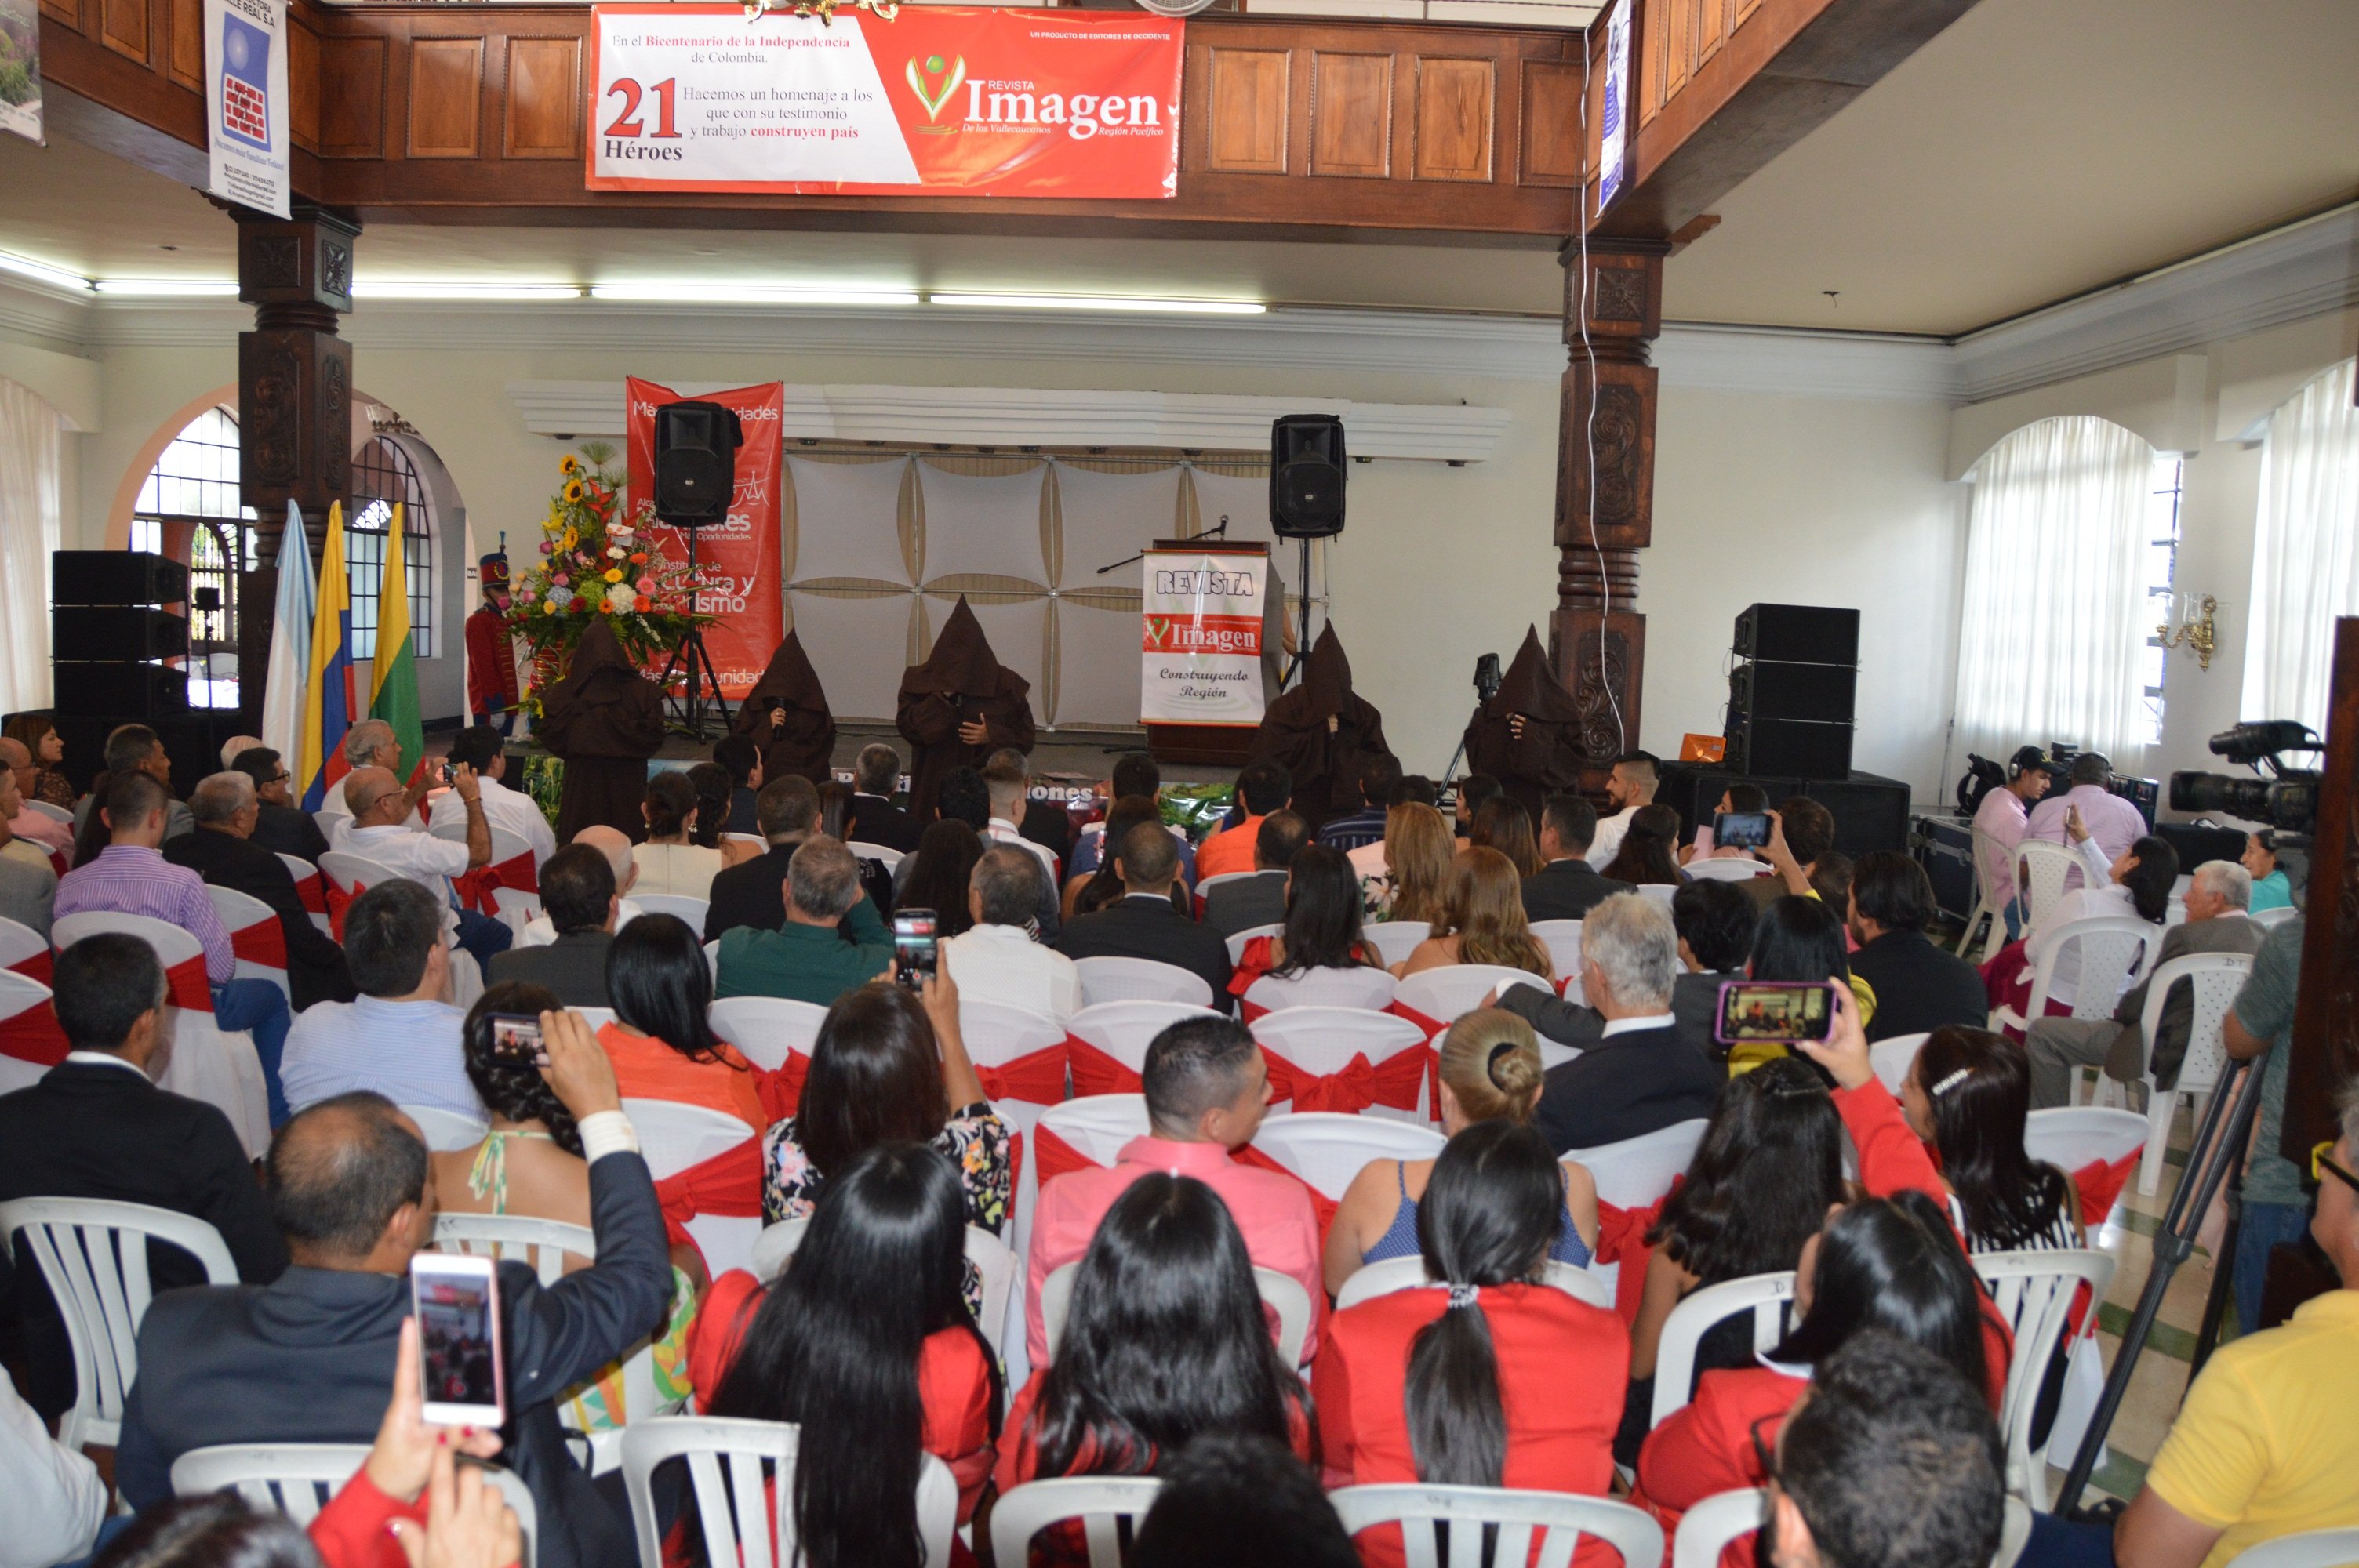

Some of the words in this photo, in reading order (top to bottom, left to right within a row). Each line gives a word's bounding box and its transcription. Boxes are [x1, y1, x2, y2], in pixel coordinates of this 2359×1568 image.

[243, 2, 262, 20] REAL
[613, 36, 627, 46] En
[632, 36, 642, 46] el
[646, 36, 723, 47] Bicentenario
[727, 36, 741, 47] de
[745, 36, 755, 47] la
[760, 36, 849, 49] Independencia
[692, 52, 705, 62] de
[709, 52, 768, 63] Colombia.
[988, 80, 1035, 91] REVISTA
[684, 87, 745, 100] Hacemos
[750, 91, 766, 100] un
[771, 87, 837, 104] homenaje
[841, 93, 848, 101] a
[854, 89, 872, 101] los
[604, 77, 682, 138] 21
[706, 109, 729, 121] que
[734, 109, 756, 118] con
[761, 109, 774, 118] su
[780, 107, 847, 120] testimonio
[964, 80, 1160, 140] Imagen
[690, 128, 698, 139] y
[702, 124, 746, 139] trabajo
[751, 126, 826, 140] construyen
[831, 126, 859, 140] país
[962, 123, 973, 132] De
[976, 124, 988, 132] los
[990, 124, 1052, 134] Vallecaucanos
[1098, 127, 1128, 137] Región
[605, 140, 682, 160] Héroes
[696, 532, 751, 541] Oportunidades
[742, 577, 754, 596] y
[1157, 570, 1253, 596] REVISTA
[1172, 624, 1256, 652] Imagen
[1160, 668, 1249, 682] Construyendo
[1180, 686, 1227, 700] Región
